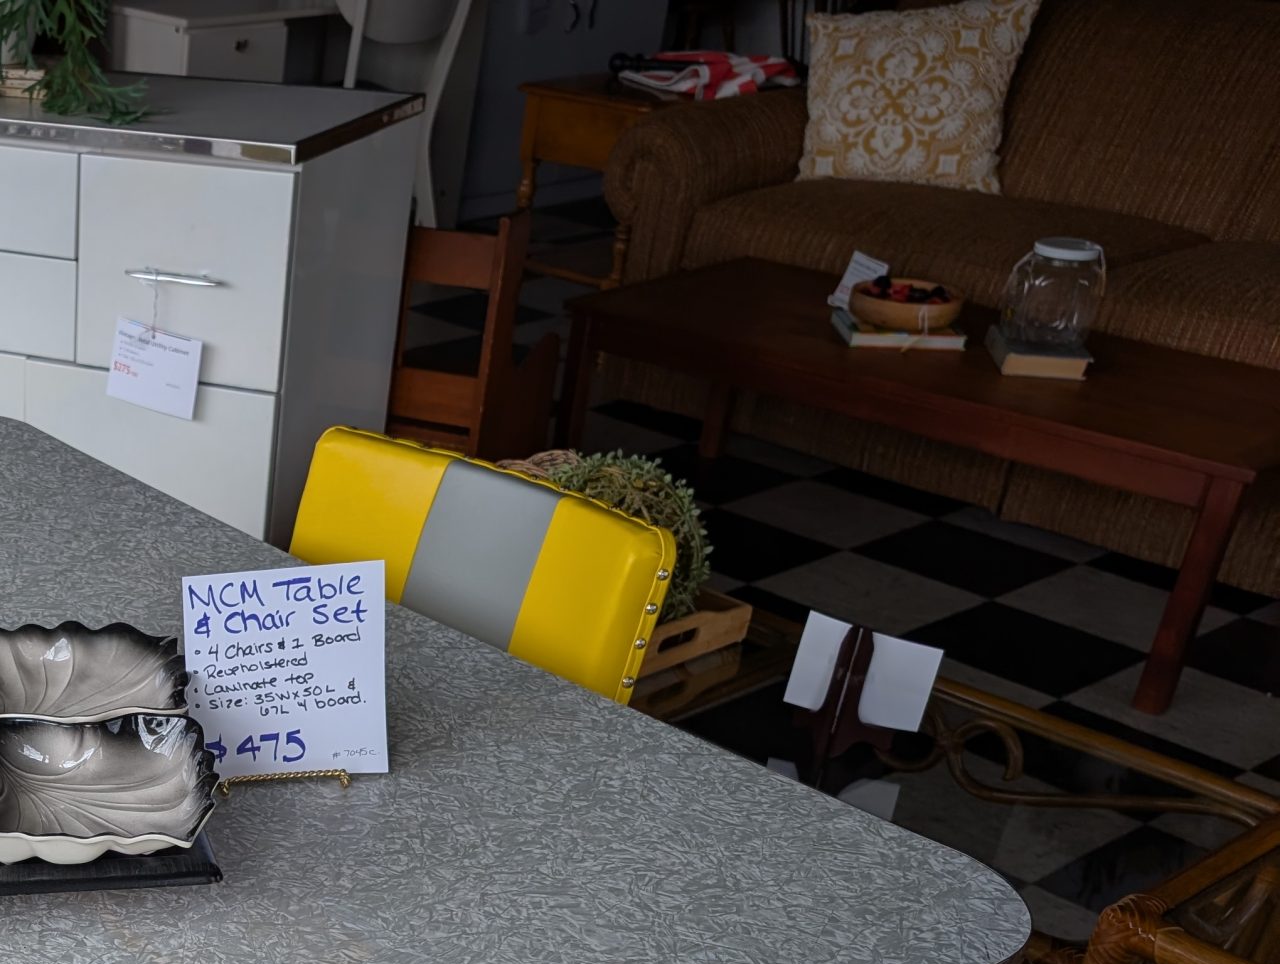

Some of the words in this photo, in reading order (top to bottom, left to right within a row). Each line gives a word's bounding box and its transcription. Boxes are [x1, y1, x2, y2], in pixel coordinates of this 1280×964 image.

[168, 346, 190, 356] Cabinet
[188, 579, 265, 614] MCM
[272, 575, 365, 602] Table
[194, 612, 211, 638] &
[224, 609, 296, 634] Chair
[313, 600, 368, 625] Set
[208, 645, 219, 662] 4
[225, 641, 273, 660] Chairs
[277, 637, 285, 651] &
[293, 638, 305, 648] 1
[312, 626, 361, 648] Board
[204, 655, 308, 680] Reupholstered
[204, 676, 278, 696] Laminate
[285, 672, 314, 686] top
[209, 697, 248, 710] Size:
[348, 678, 356, 691] &
[260, 704, 290, 717] 67L
[315, 691, 366, 709] board.
